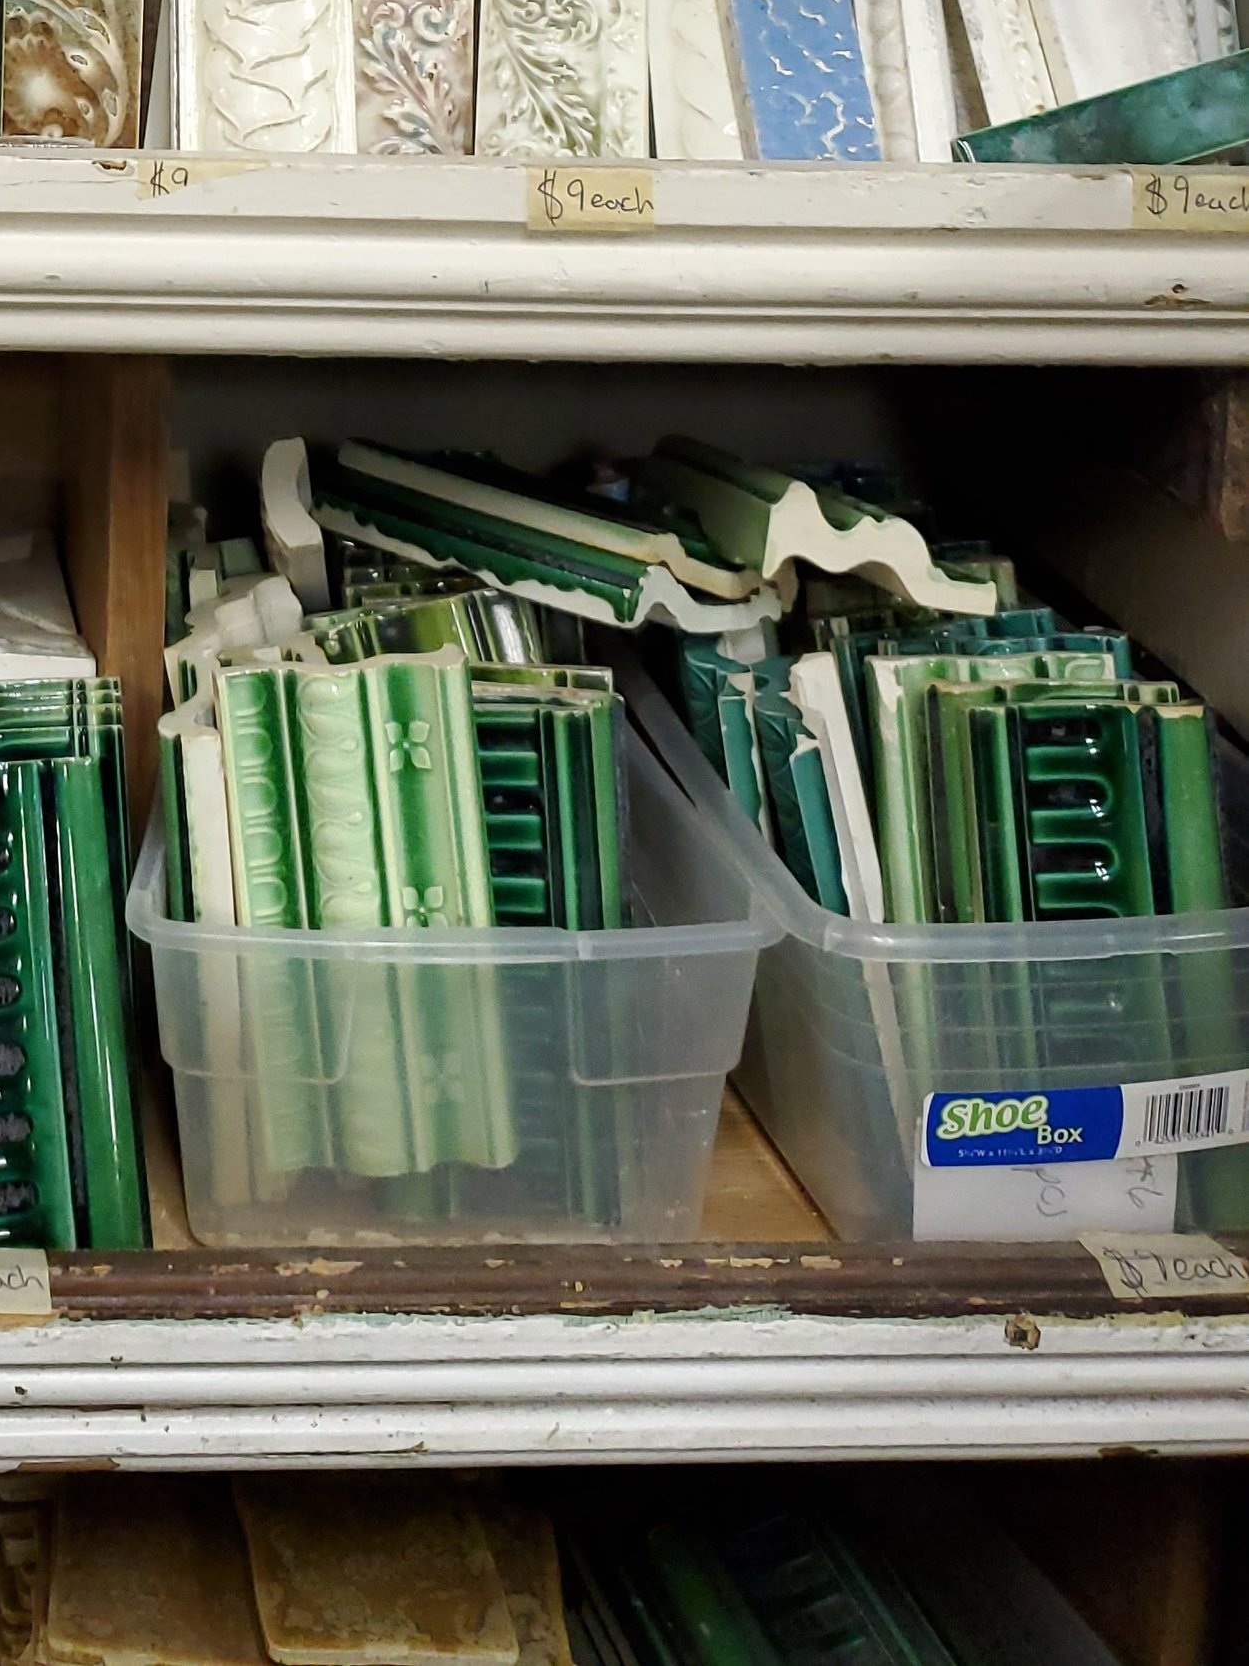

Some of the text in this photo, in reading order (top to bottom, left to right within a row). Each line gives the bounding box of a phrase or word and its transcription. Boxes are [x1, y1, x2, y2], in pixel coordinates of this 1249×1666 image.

[537, 169, 654, 226] $9 each
[1145, 172, 1189, 219] $9
[938, 1096, 1048, 1138] Shoe
[1037, 1124, 1083, 1145] Box
[1173, 1255, 1246, 1282] each
